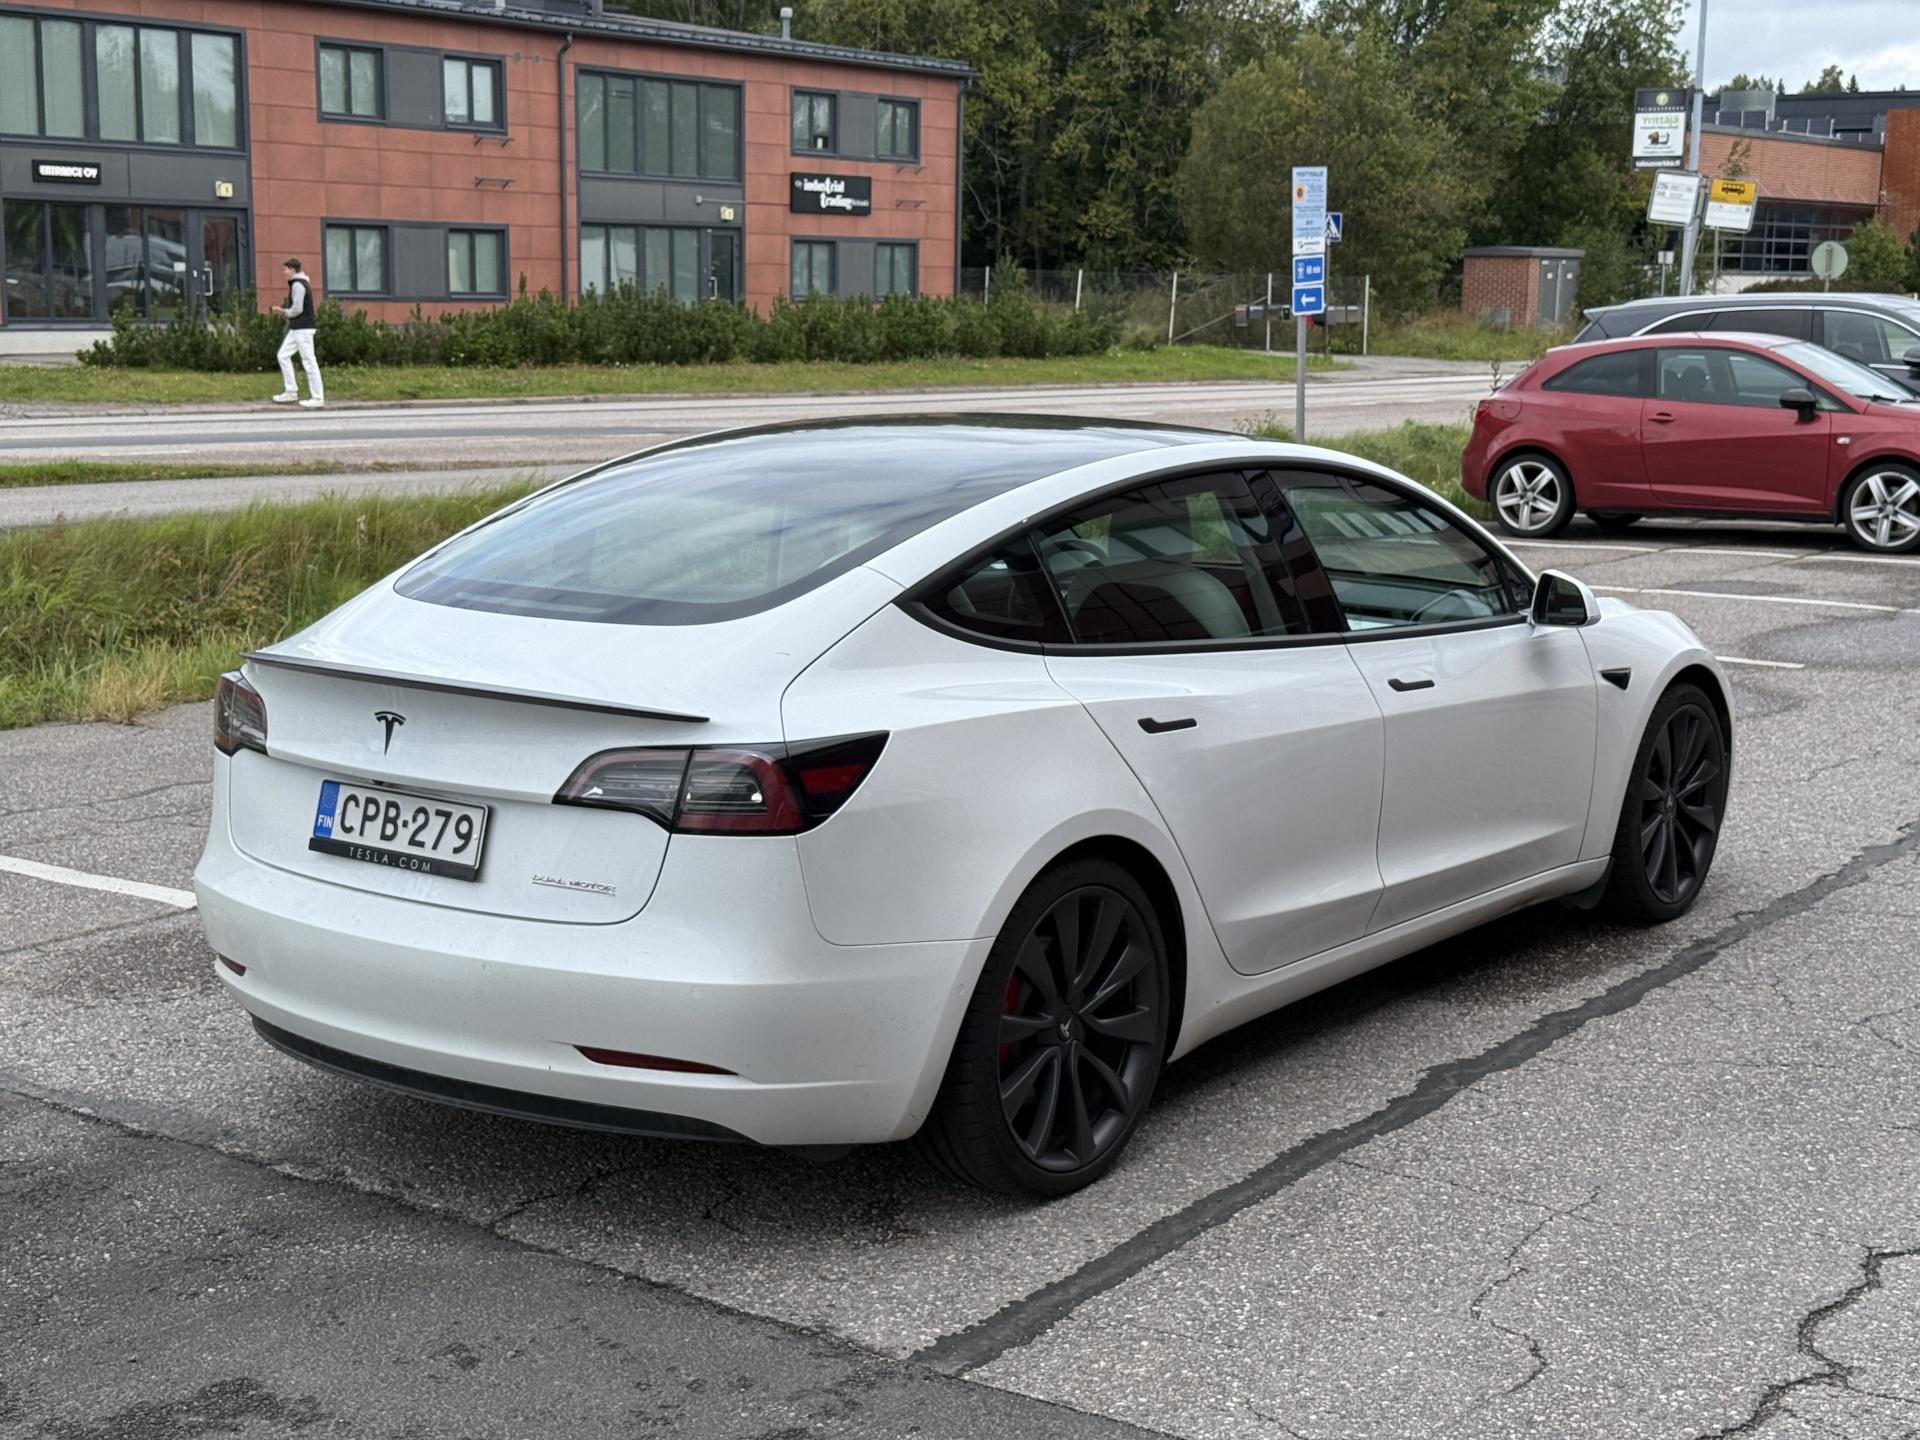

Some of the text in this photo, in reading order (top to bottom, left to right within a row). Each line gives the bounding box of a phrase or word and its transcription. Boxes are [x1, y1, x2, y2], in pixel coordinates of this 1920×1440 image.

[317, 814, 333, 828] FIN
[340, 793, 474, 854] CPB-279
[349, 846, 432, 872] TESLA.COM
[532, 874, 616, 893] DUAL MOTOR
